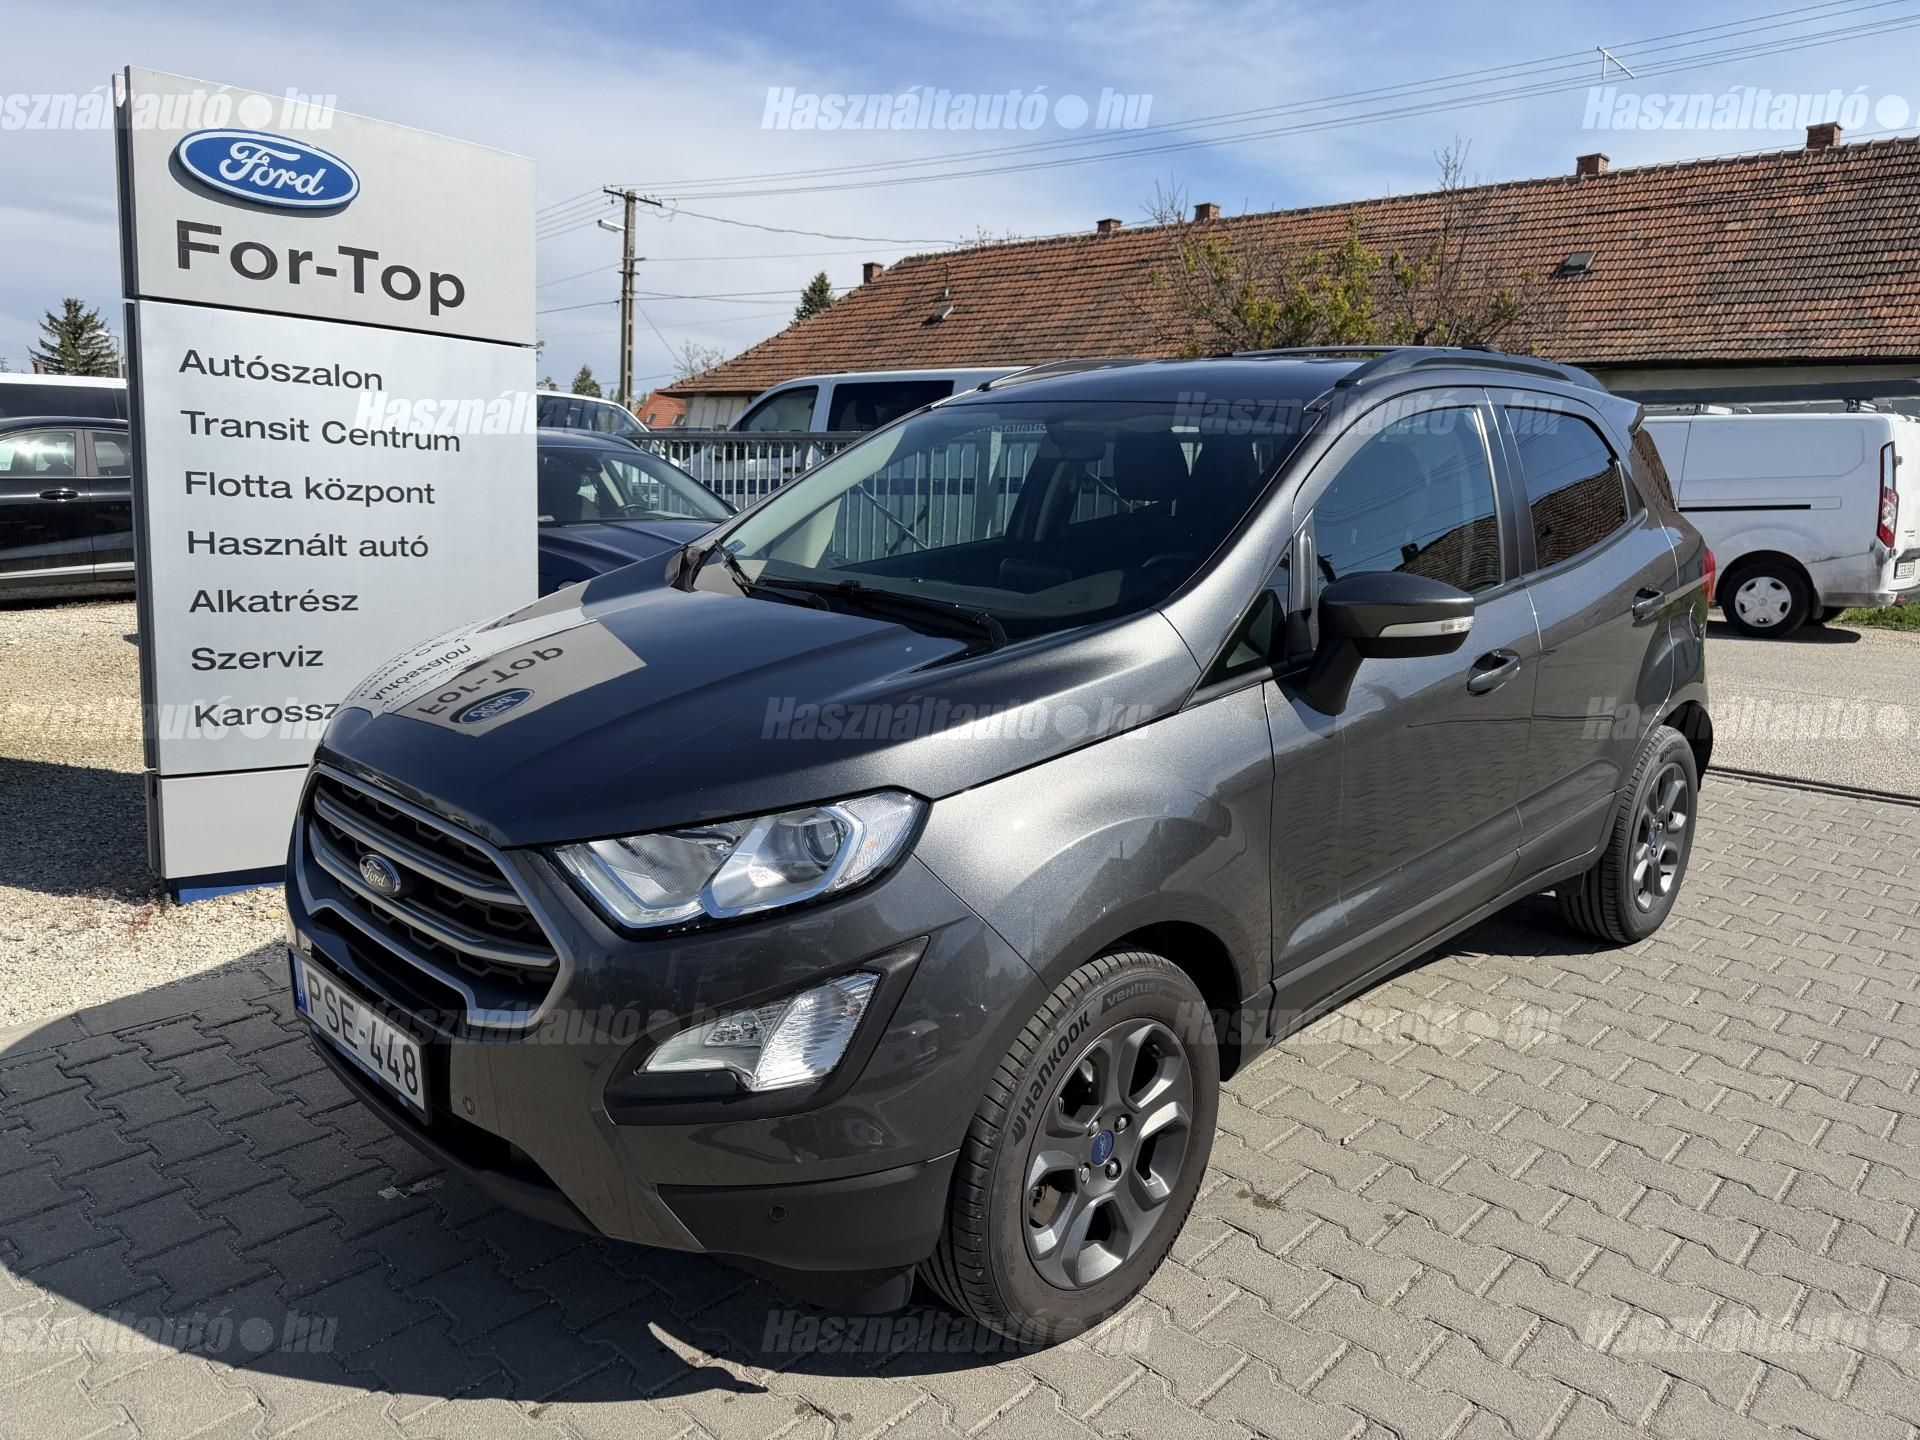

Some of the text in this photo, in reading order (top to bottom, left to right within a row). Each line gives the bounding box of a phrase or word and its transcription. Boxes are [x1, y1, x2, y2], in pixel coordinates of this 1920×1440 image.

[219, 140, 326, 197] Ford
[176, 219, 465, 317] For-Top
[178, 349, 383, 391] Autószalon
[180, 409, 460, 452] Transit Centrum
[185, 470, 435, 508] Flotta központ
[187, 530, 429, 558] Használt autó
[188, 588, 359, 613] Alkatrész
[191, 644, 324, 672] Szerviz
[306, 968, 419, 1096] PSE-448
